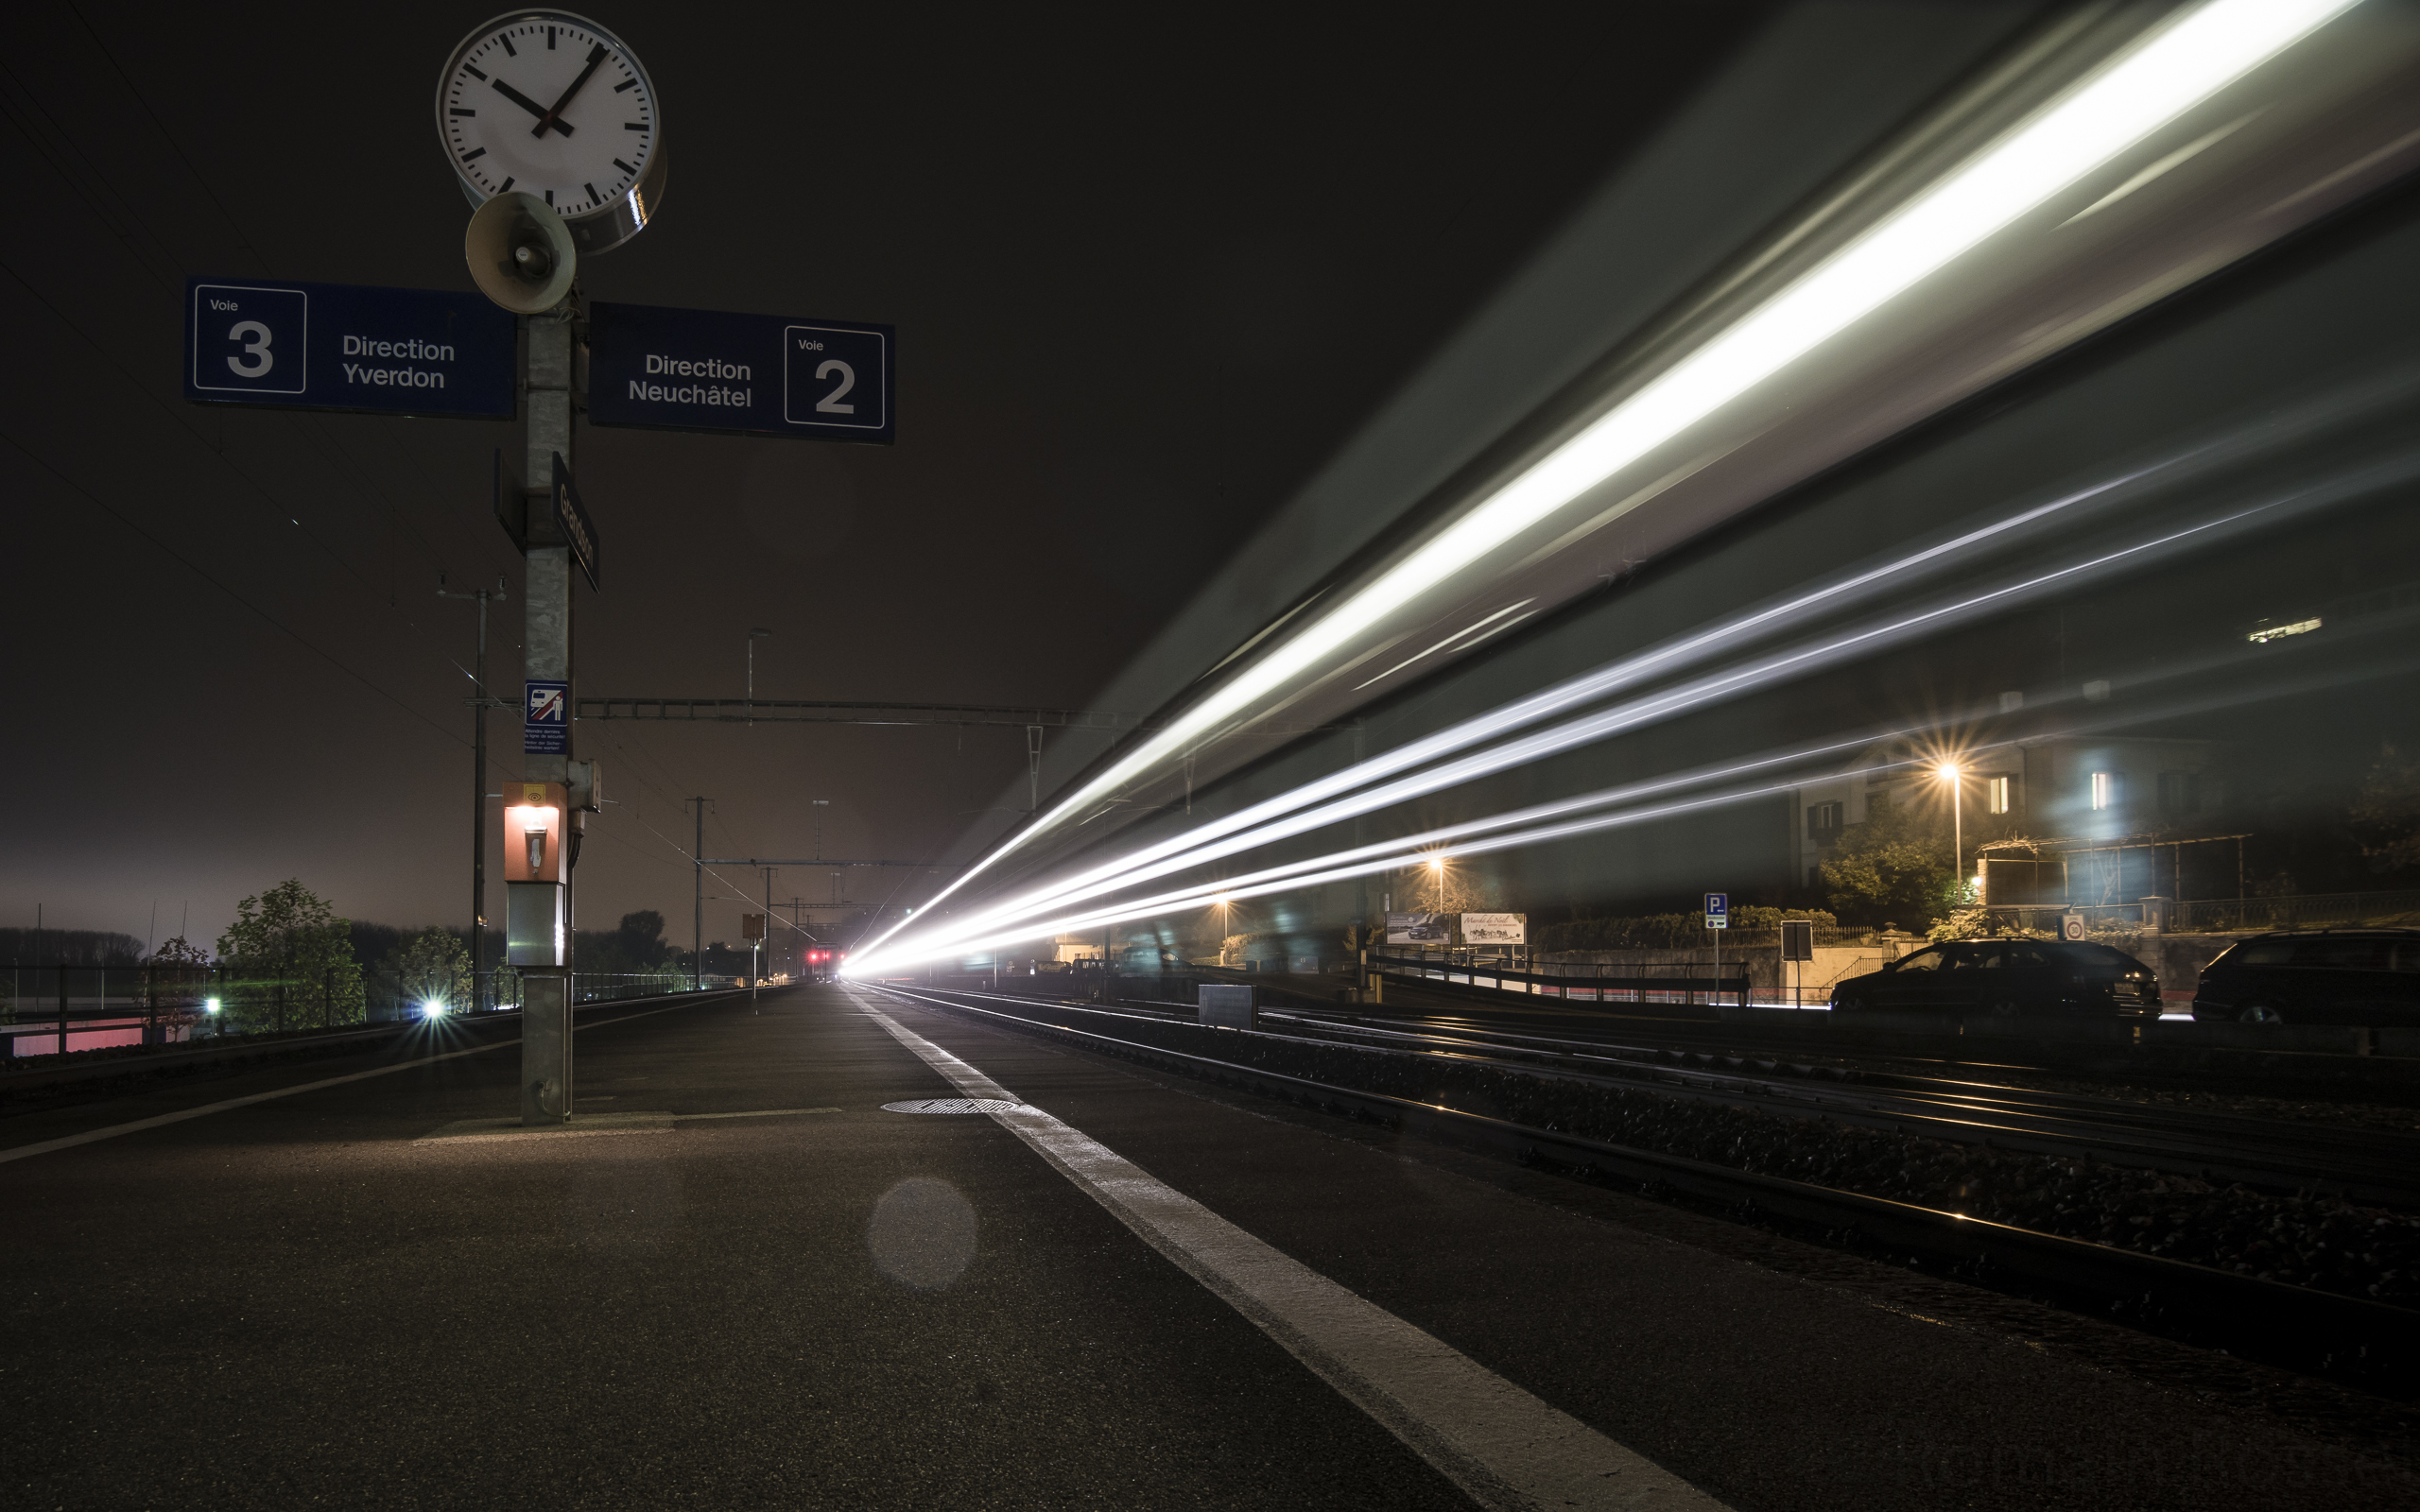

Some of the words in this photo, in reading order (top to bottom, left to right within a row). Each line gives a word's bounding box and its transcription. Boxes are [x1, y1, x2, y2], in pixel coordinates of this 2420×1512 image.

[210, 299, 238, 311] Voie
[227, 320, 273, 378] 3
[343, 335, 455, 361] Direction
[798, 339, 823, 351] Voie
[342, 363, 445, 388] Yverdon
[646, 354, 751, 381] Direction
[629, 380, 752, 407] Neuchâtel
[815, 359, 856, 414] 2
[560, 483, 594, 568] Grandson
[1710, 897, 1720, 913] P
[2071, 926, 2079, 935] 30
